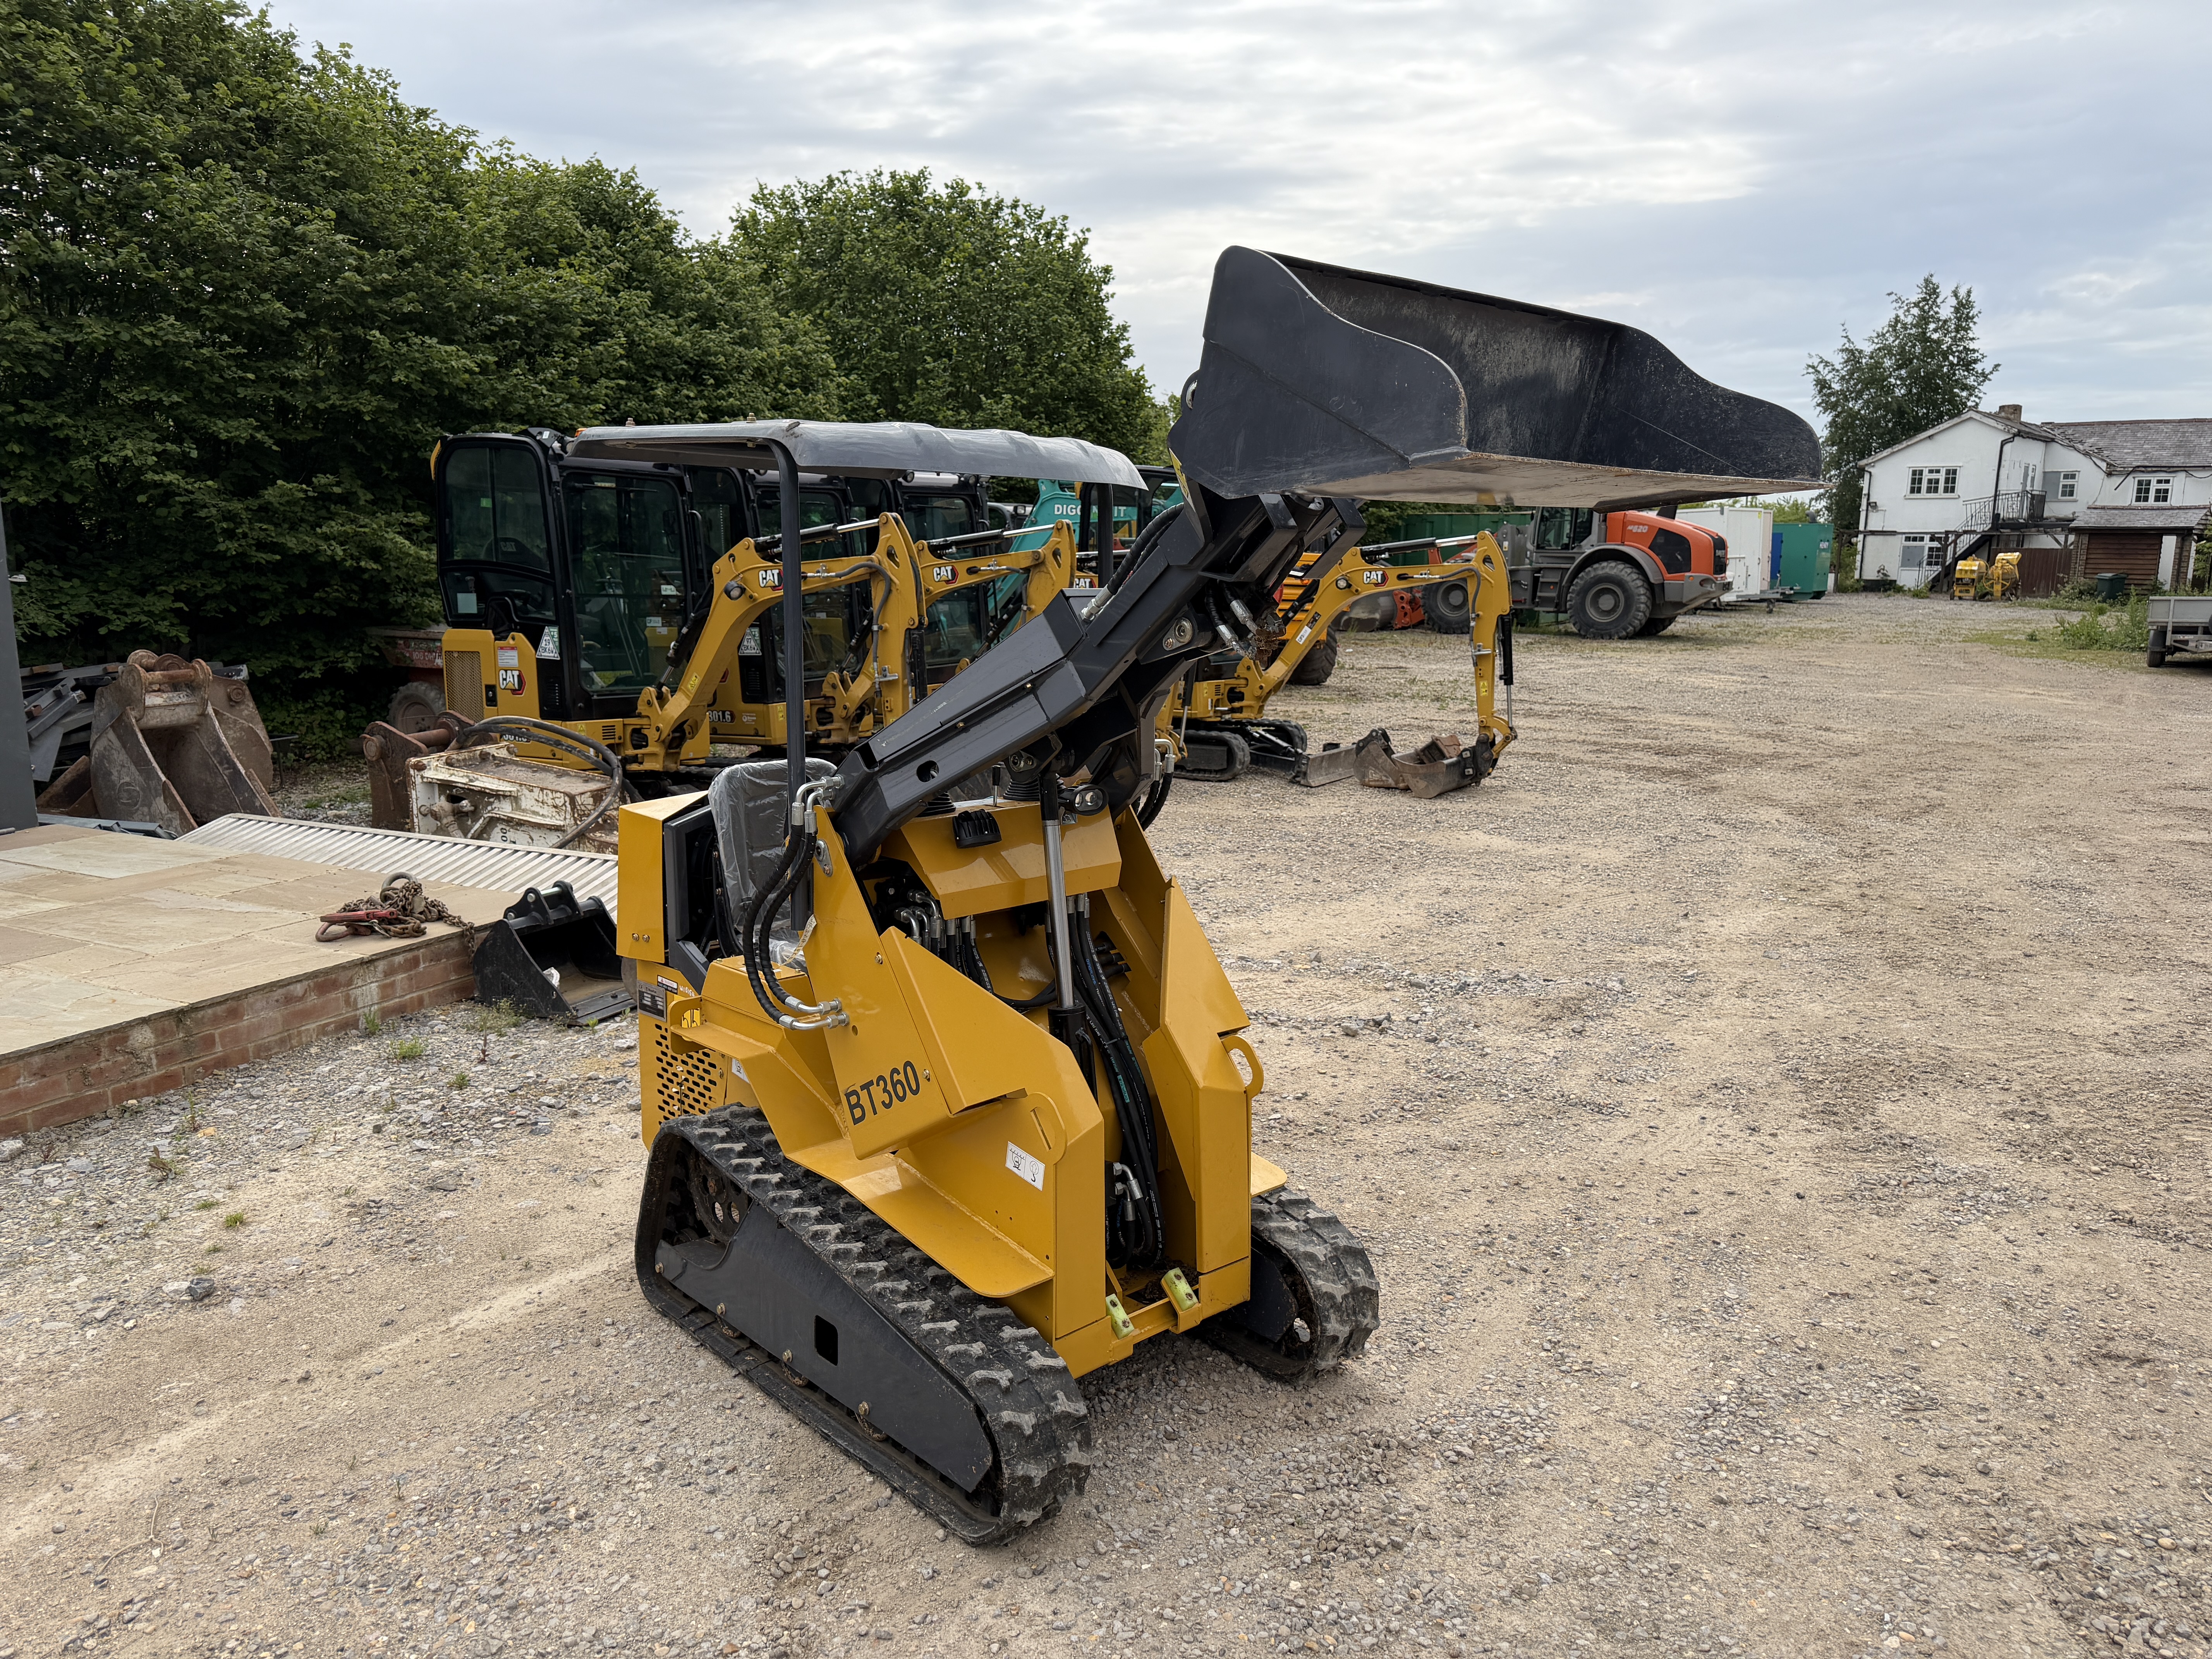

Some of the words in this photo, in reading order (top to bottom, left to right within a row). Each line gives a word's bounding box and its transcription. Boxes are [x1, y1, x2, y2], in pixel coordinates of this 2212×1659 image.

[1114, 506, 1127, 517] IT
[500, 542, 517, 551] CAT
[759, 569, 779, 587] CAT
[933, 566, 952, 582] CAT
[1364, 571, 1383, 584] CAT
[1073, 578, 1091, 588] CAT
[499, 670, 519, 689] CAT
[708, 710, 731, 723] 301.6
[844, 1060, 920, 1125] BT360
